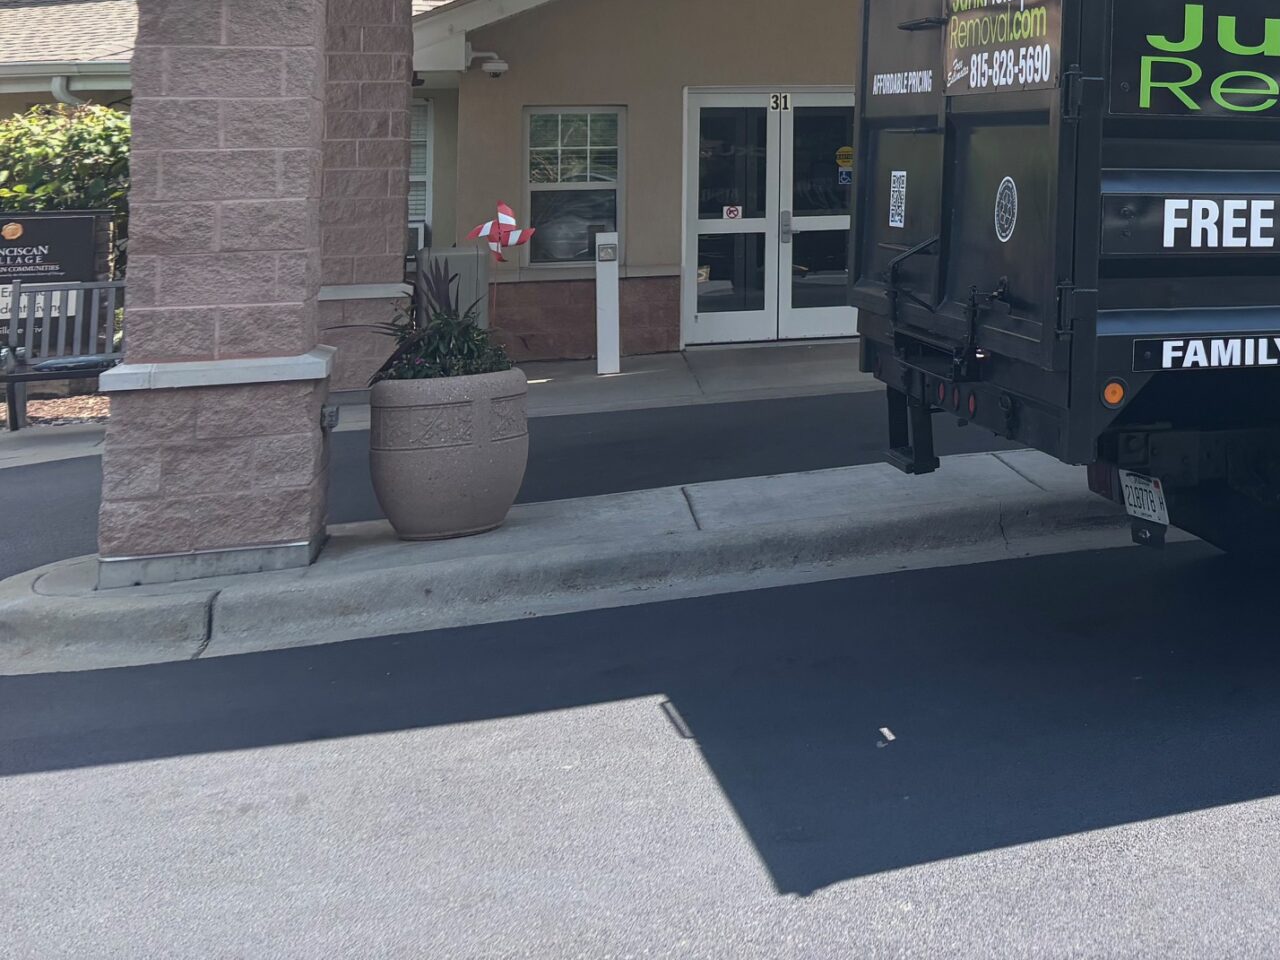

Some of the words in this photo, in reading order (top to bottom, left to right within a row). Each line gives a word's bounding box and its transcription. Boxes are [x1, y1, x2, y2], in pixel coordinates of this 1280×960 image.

[950, 4, 1047, 49] Removal.com
[873, 72, 908, 95] AFFORDABLE
[908, 70, 933, 93] PRICING
[969, 43, 1051, 89] 815-828-5690
[771, 94, 789, 110] 31
[1162, 199, 1275, 248] FREE
